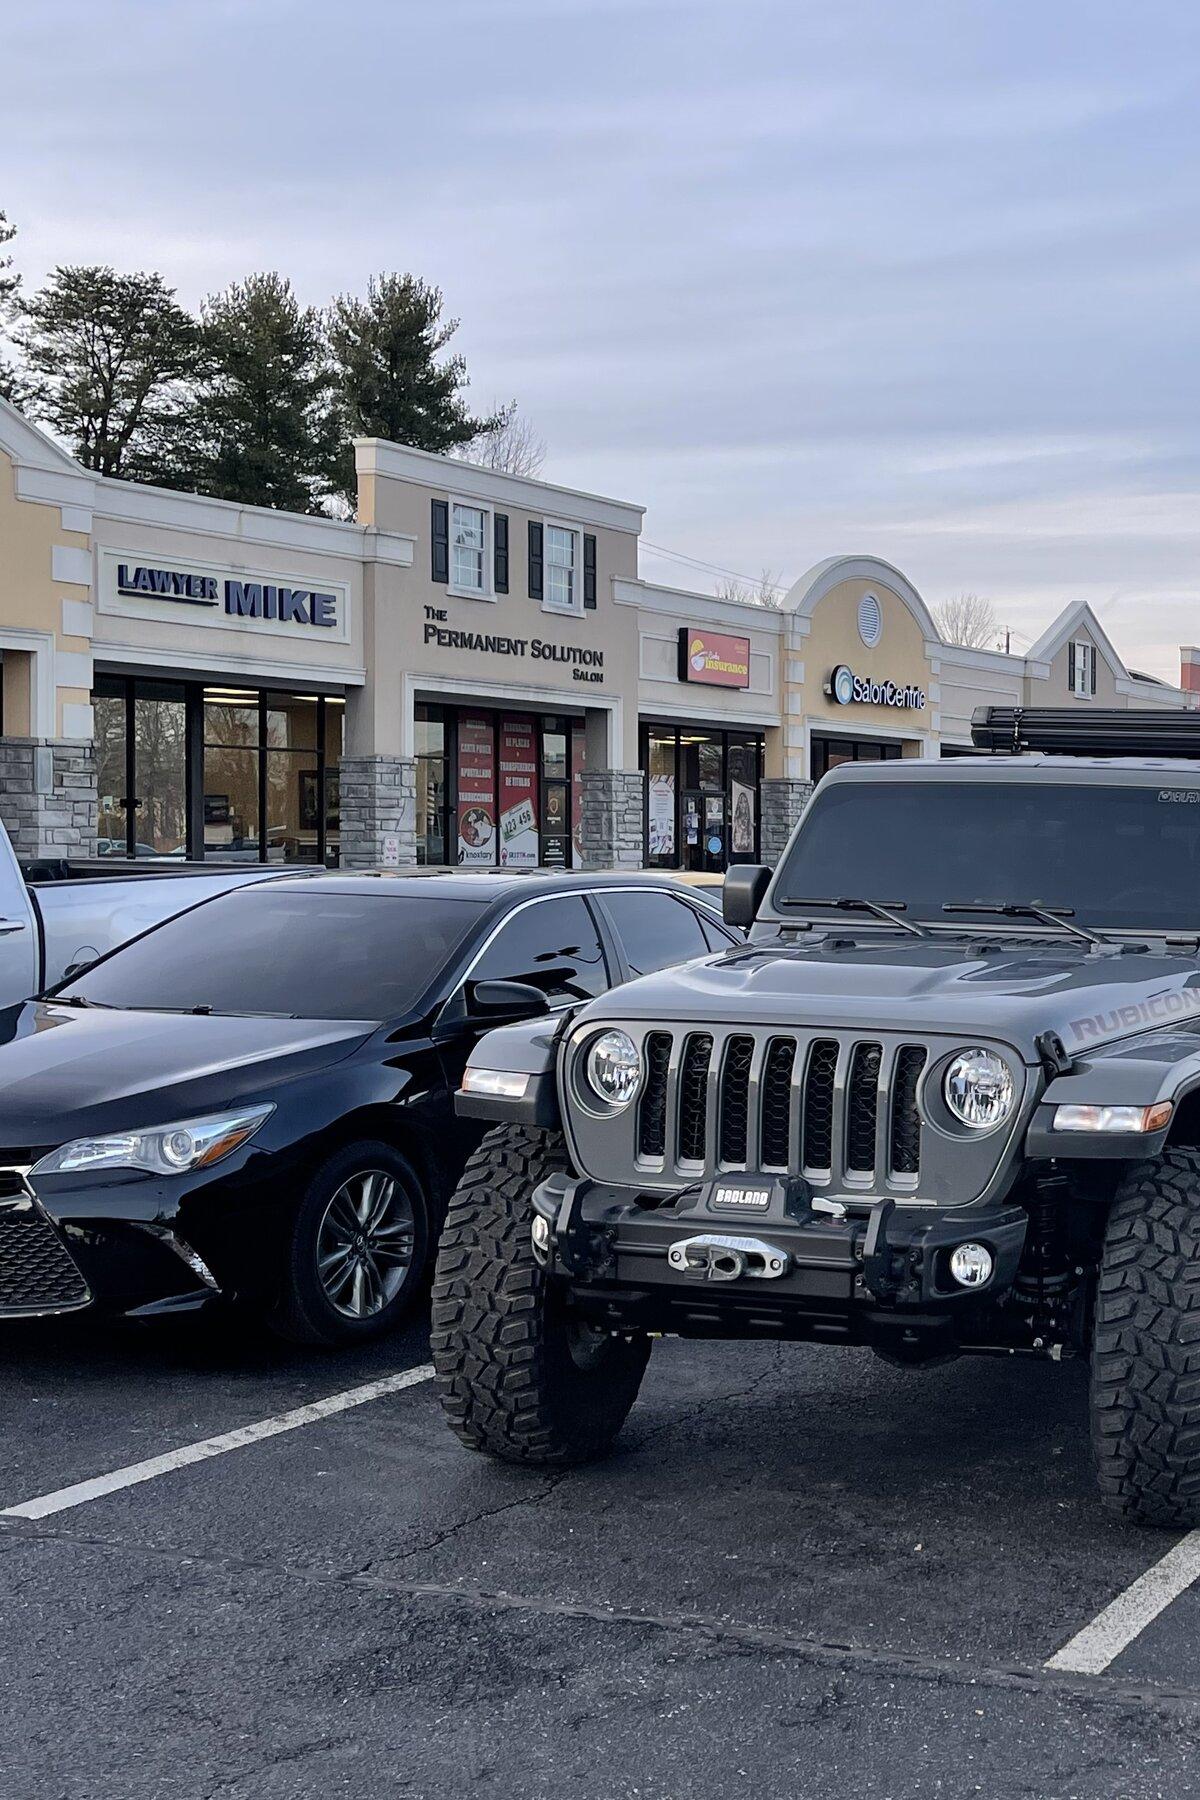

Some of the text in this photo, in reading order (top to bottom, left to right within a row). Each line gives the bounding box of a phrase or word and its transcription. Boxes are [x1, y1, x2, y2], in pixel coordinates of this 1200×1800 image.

[118, 564, 337, 627] LAWYER MIKE
[424, 605, 448, 622] THE
[424, 623, 604, 667] PERMANENT SOLUTION
[572, 668, 604, 683] SALON
[853, 675, 926, 710] SalonCentric
[1069, 987, 1200, 1041] RUBICON
[715, 1189, 769, 1206] BADLAND
